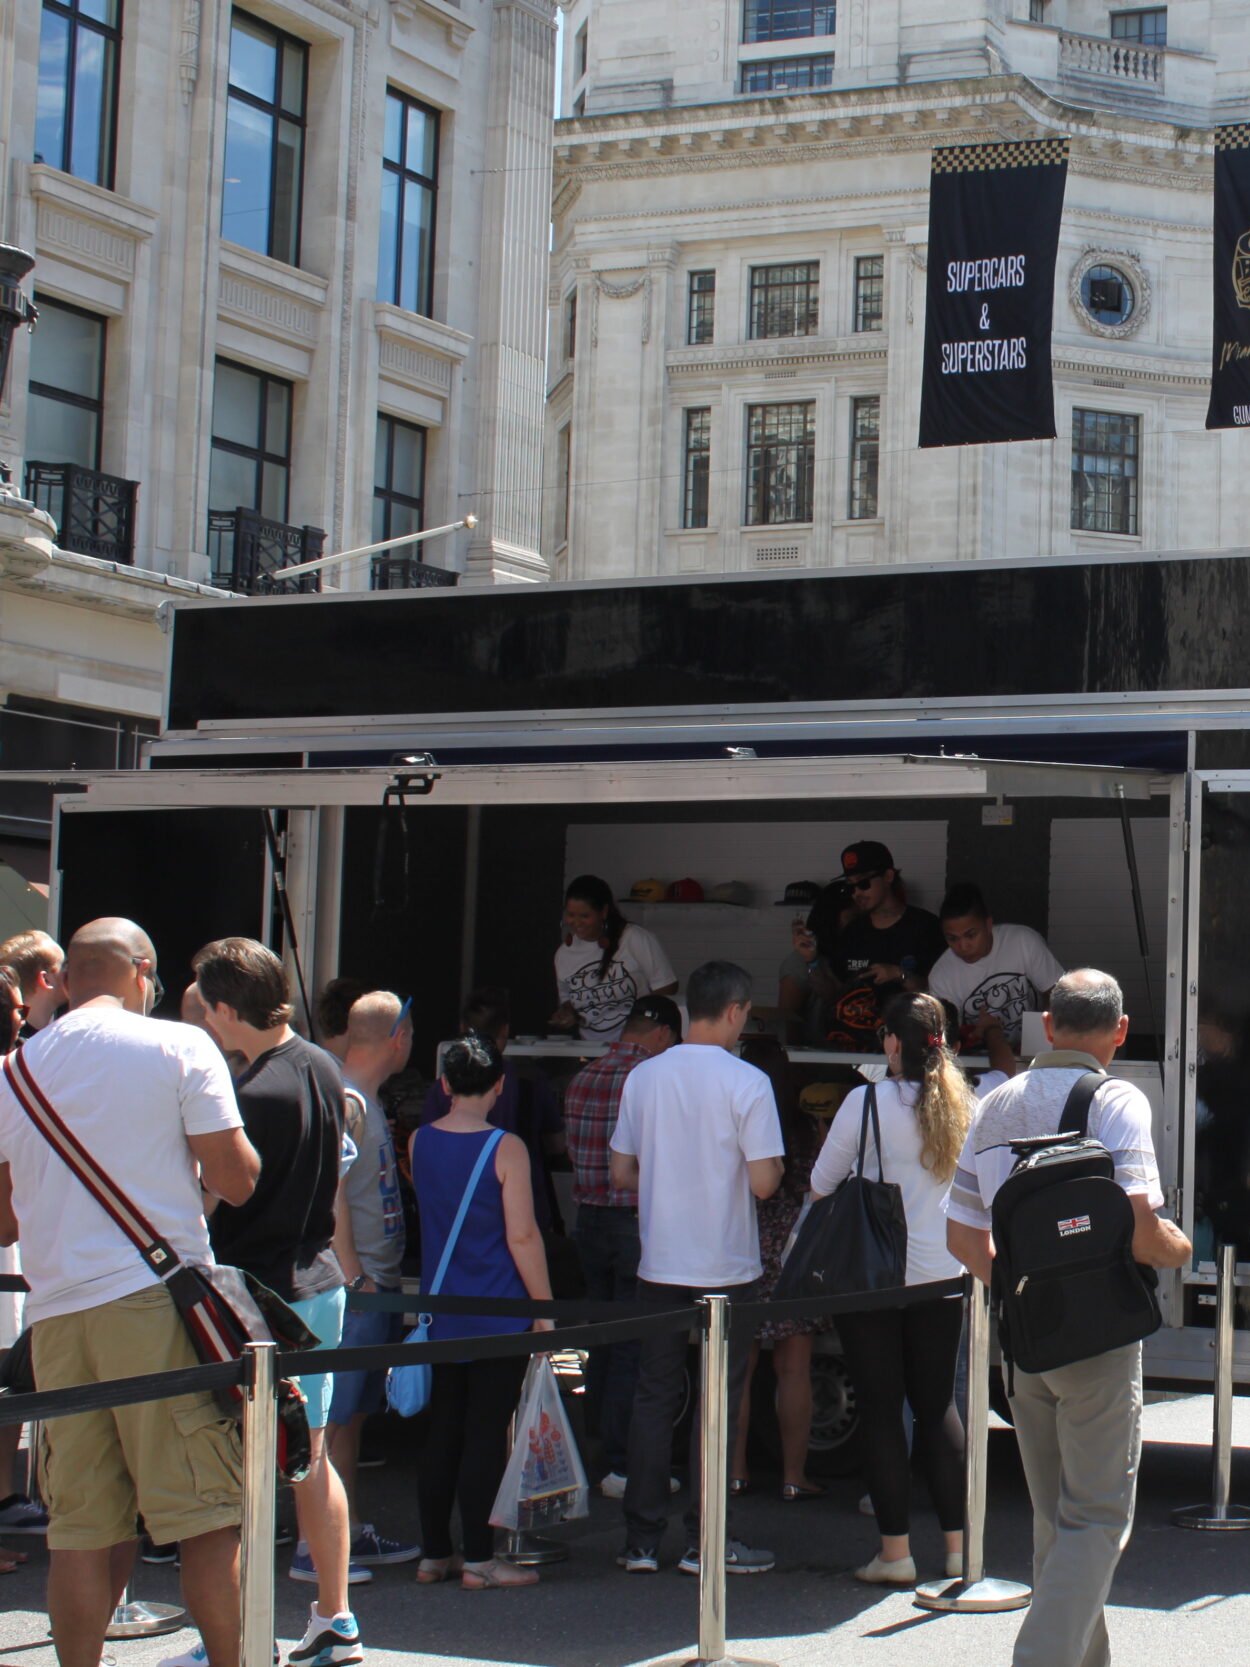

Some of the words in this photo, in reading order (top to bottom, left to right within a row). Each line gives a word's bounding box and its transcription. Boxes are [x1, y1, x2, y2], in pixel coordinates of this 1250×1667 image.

[946, 254, 1025, 292] SUPERCARS
[979, 303, 990, 330] &
[941, 337, 1027, 374] SUPERSTARS
[1060, 1225, 1091, 1237] LONDON
